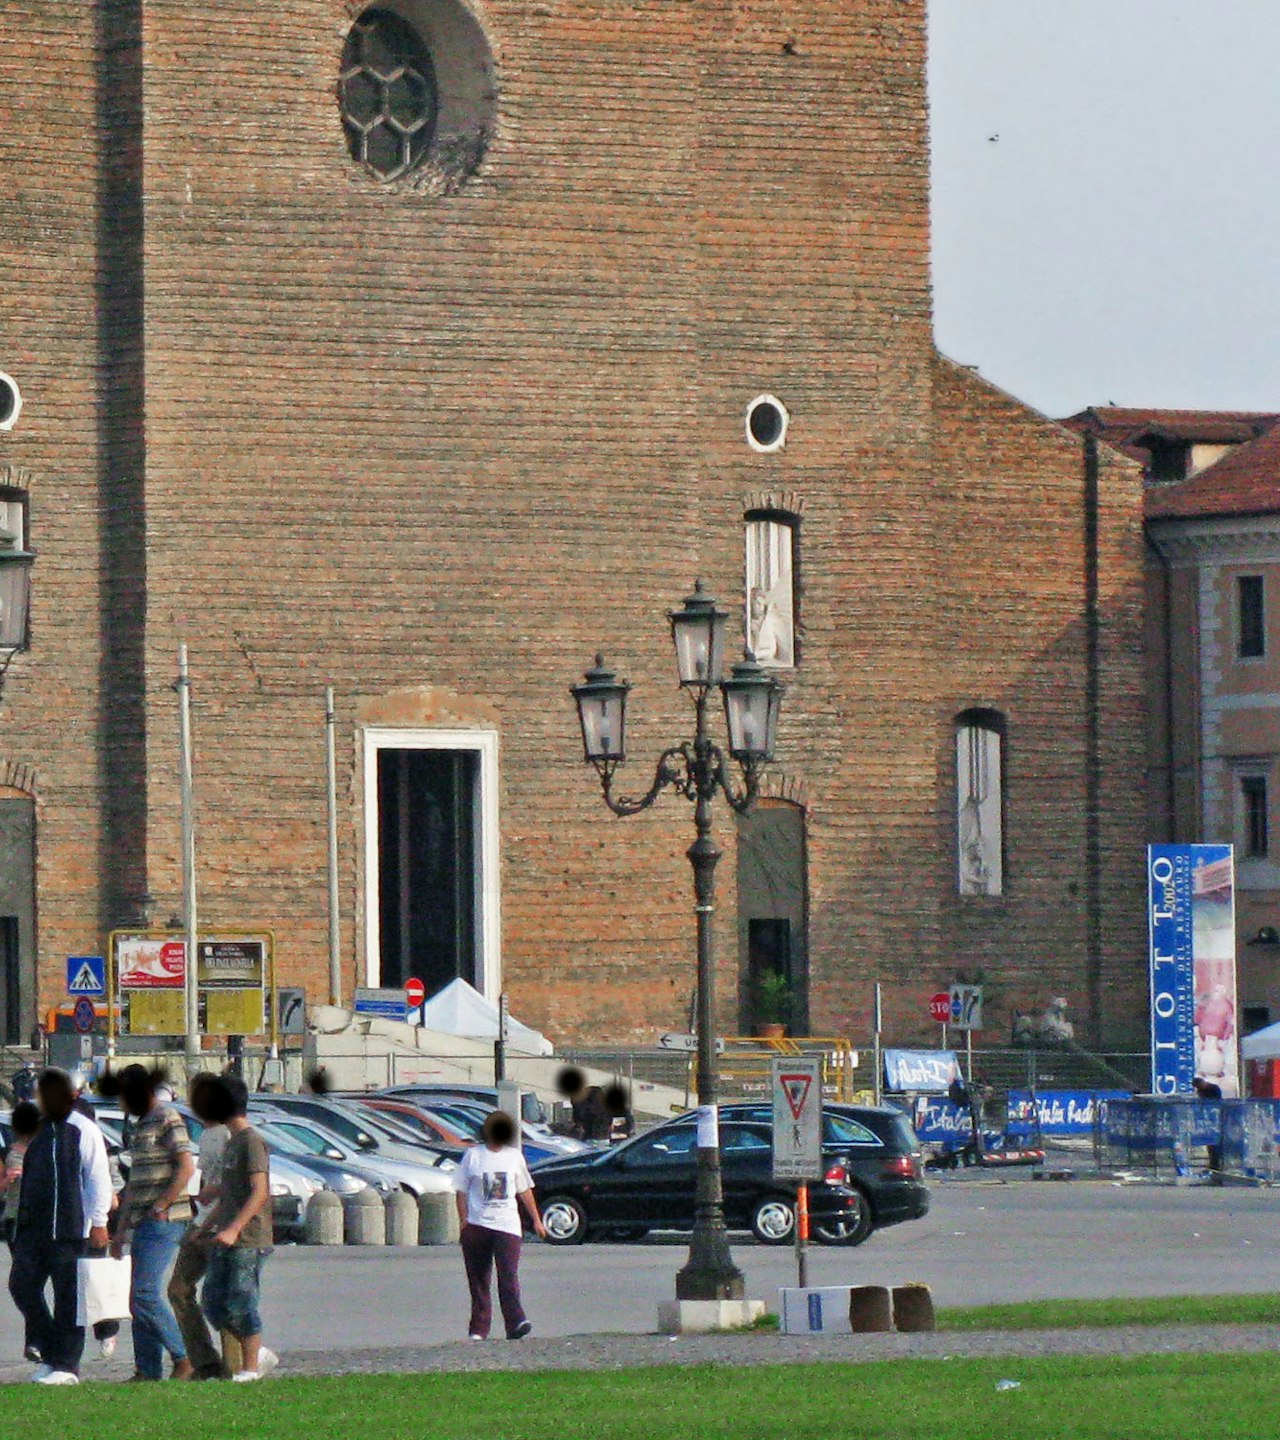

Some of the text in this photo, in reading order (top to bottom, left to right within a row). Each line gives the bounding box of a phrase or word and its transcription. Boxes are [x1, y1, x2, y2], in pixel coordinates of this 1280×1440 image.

[1163, 880, 1176, 911] 2002
[1176, 855, 1184, 932] RESTAURO
[1152, 857, 1176, 1095] GIOTTO
[1177, 945, 1185, 971] DEL
[930, 1002, 949, 1013] STO
[1177, 987, 1187, 1070] SPLENDORE
